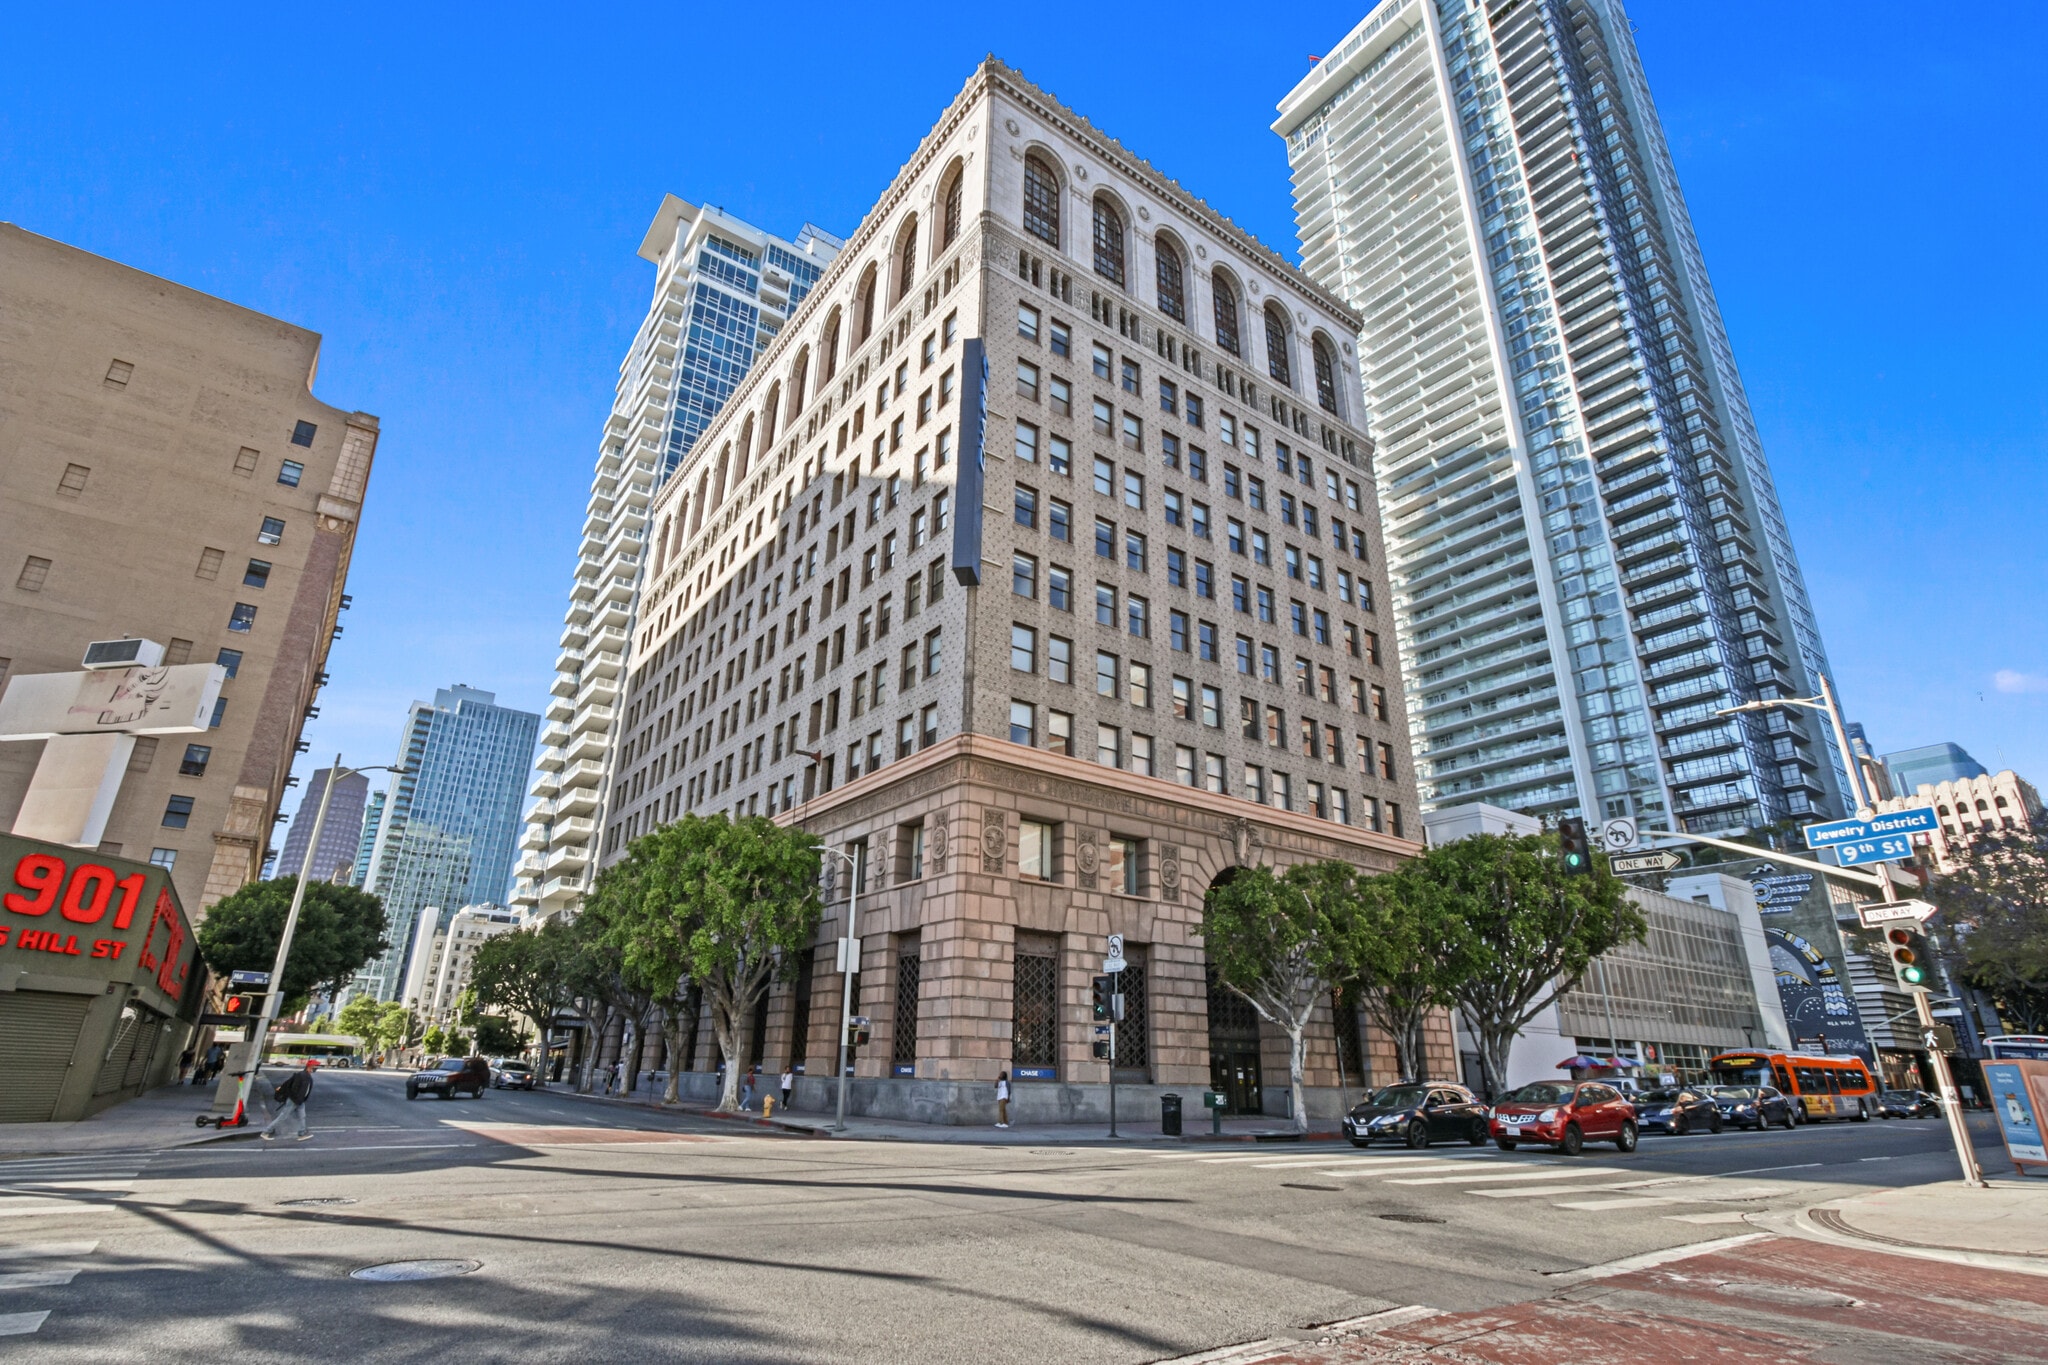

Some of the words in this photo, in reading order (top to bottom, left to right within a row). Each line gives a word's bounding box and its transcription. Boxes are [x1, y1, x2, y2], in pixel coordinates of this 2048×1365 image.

[1814, 825, 1865, 841] Jewelry
[1871, 815, 1928, 832] District
[1618, 859, 1640, 870] ONE
[1644, 856, 1664, 867] WAY
[1842, 843, 1875, 862] 9th
[1881, 840, 1906, 855] St
[3, 853, 147, 930] 901
[1869, 911, 1887, 920] ONE
[1892, 908, 1911, 916] WAY
[16, 929, 81, 956] HILL
[90, 939, 127, 960] ST
